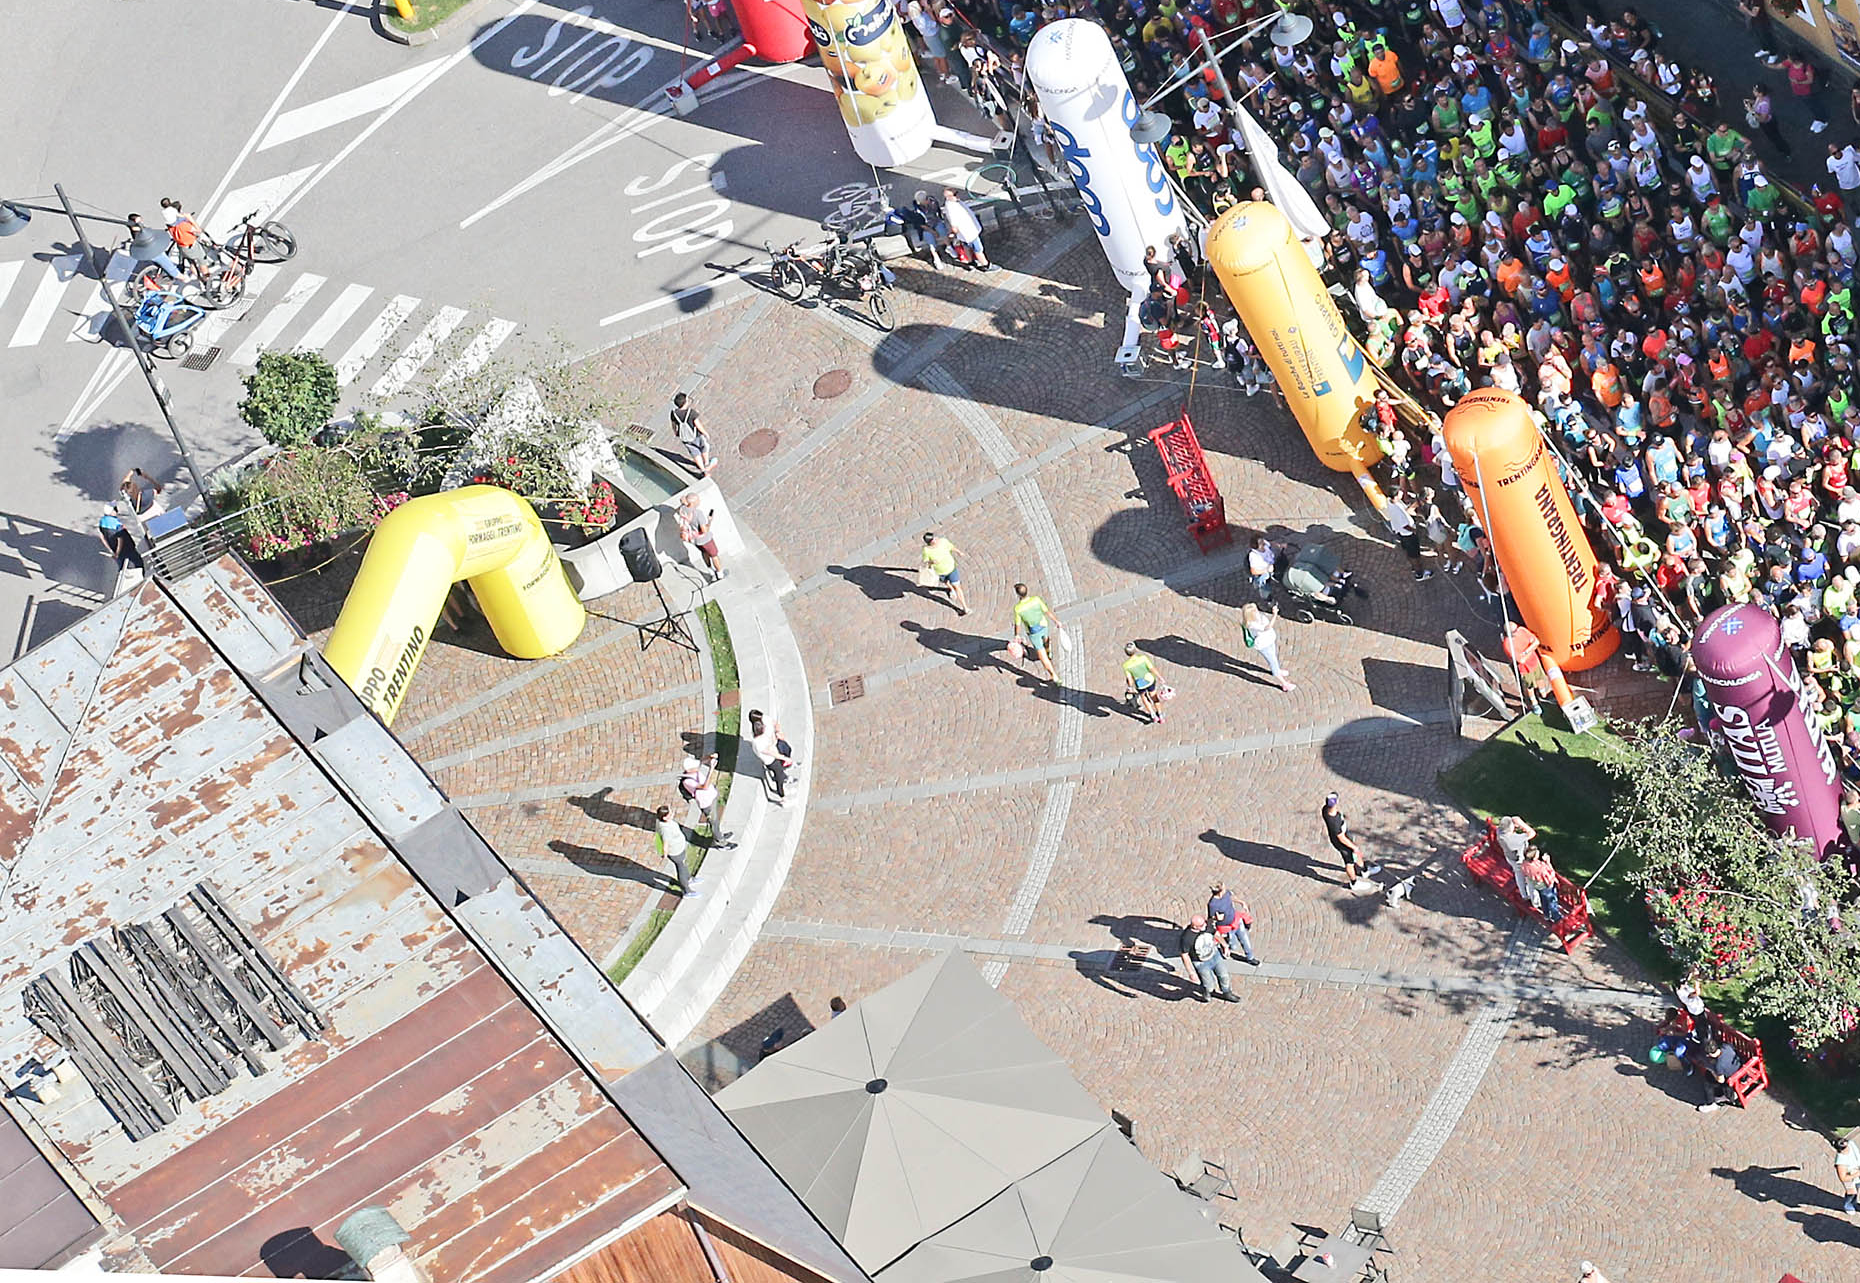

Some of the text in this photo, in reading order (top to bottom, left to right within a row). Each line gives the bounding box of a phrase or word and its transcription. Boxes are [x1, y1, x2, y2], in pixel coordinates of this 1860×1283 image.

[511, 5, 655, 106] STOP
[624, 153, 735, 259] STOP
[1051, 120, 1111, 238] coop
[1534, 482, 1588, 593] TRENTINGRANA
[360, 667, 386, 709] UPPO
[383, 625, 424, 710] TRENTINO
[1713, 702, 1769, 776] ITAS
[1755, 716, 1788, 774] MUTUA
